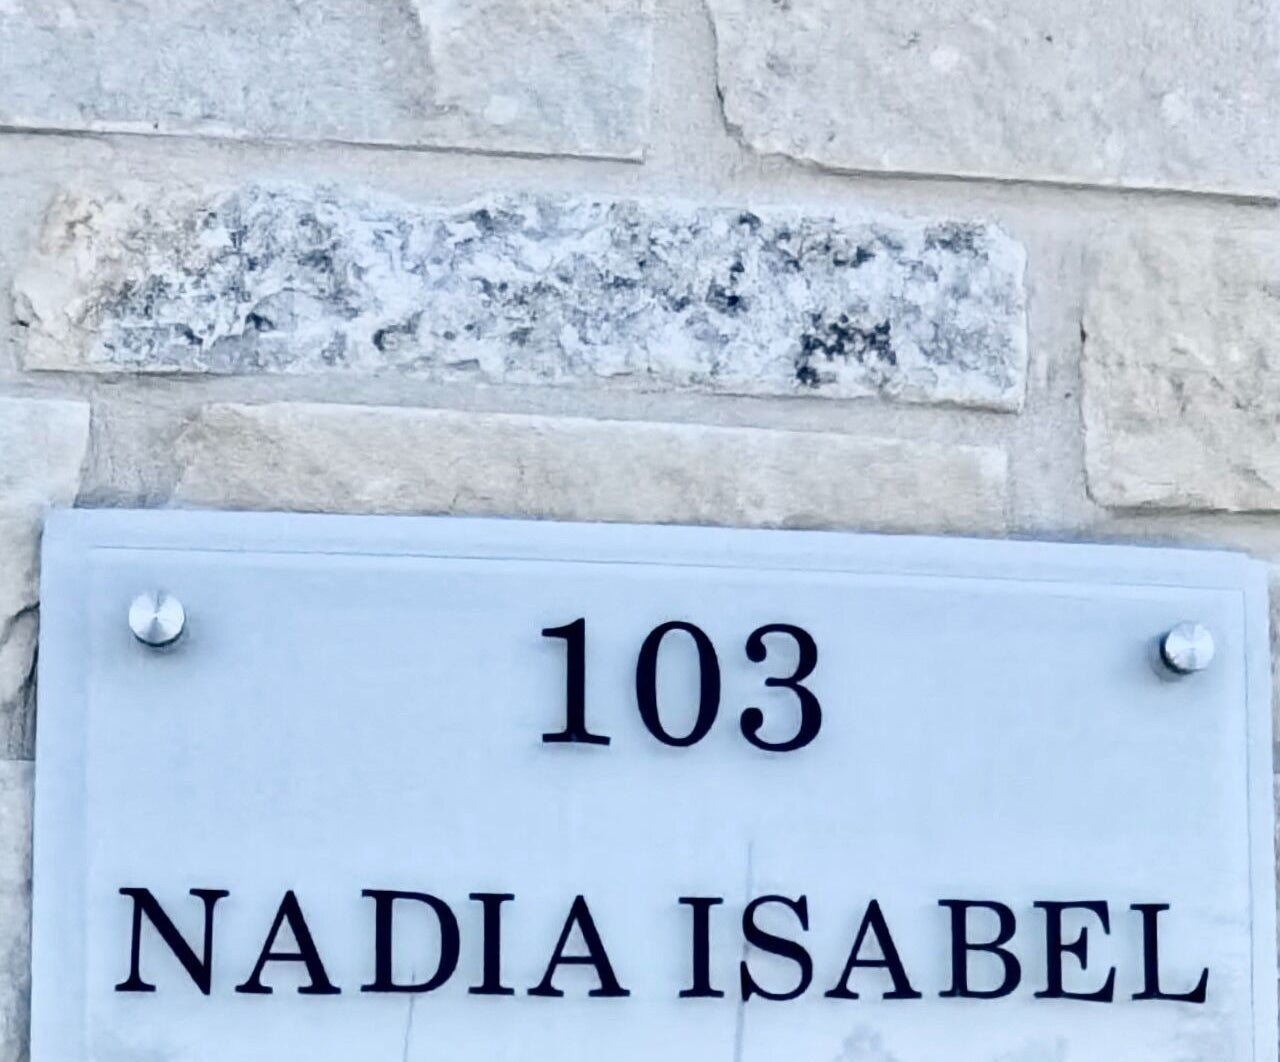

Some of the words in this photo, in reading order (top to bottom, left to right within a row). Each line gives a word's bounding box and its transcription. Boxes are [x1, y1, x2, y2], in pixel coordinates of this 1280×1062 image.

[541, 617, 822, 753] 103
[115, 887, 631, 998] NADIA
[678, 894, 1209, 1004] ISABEL
